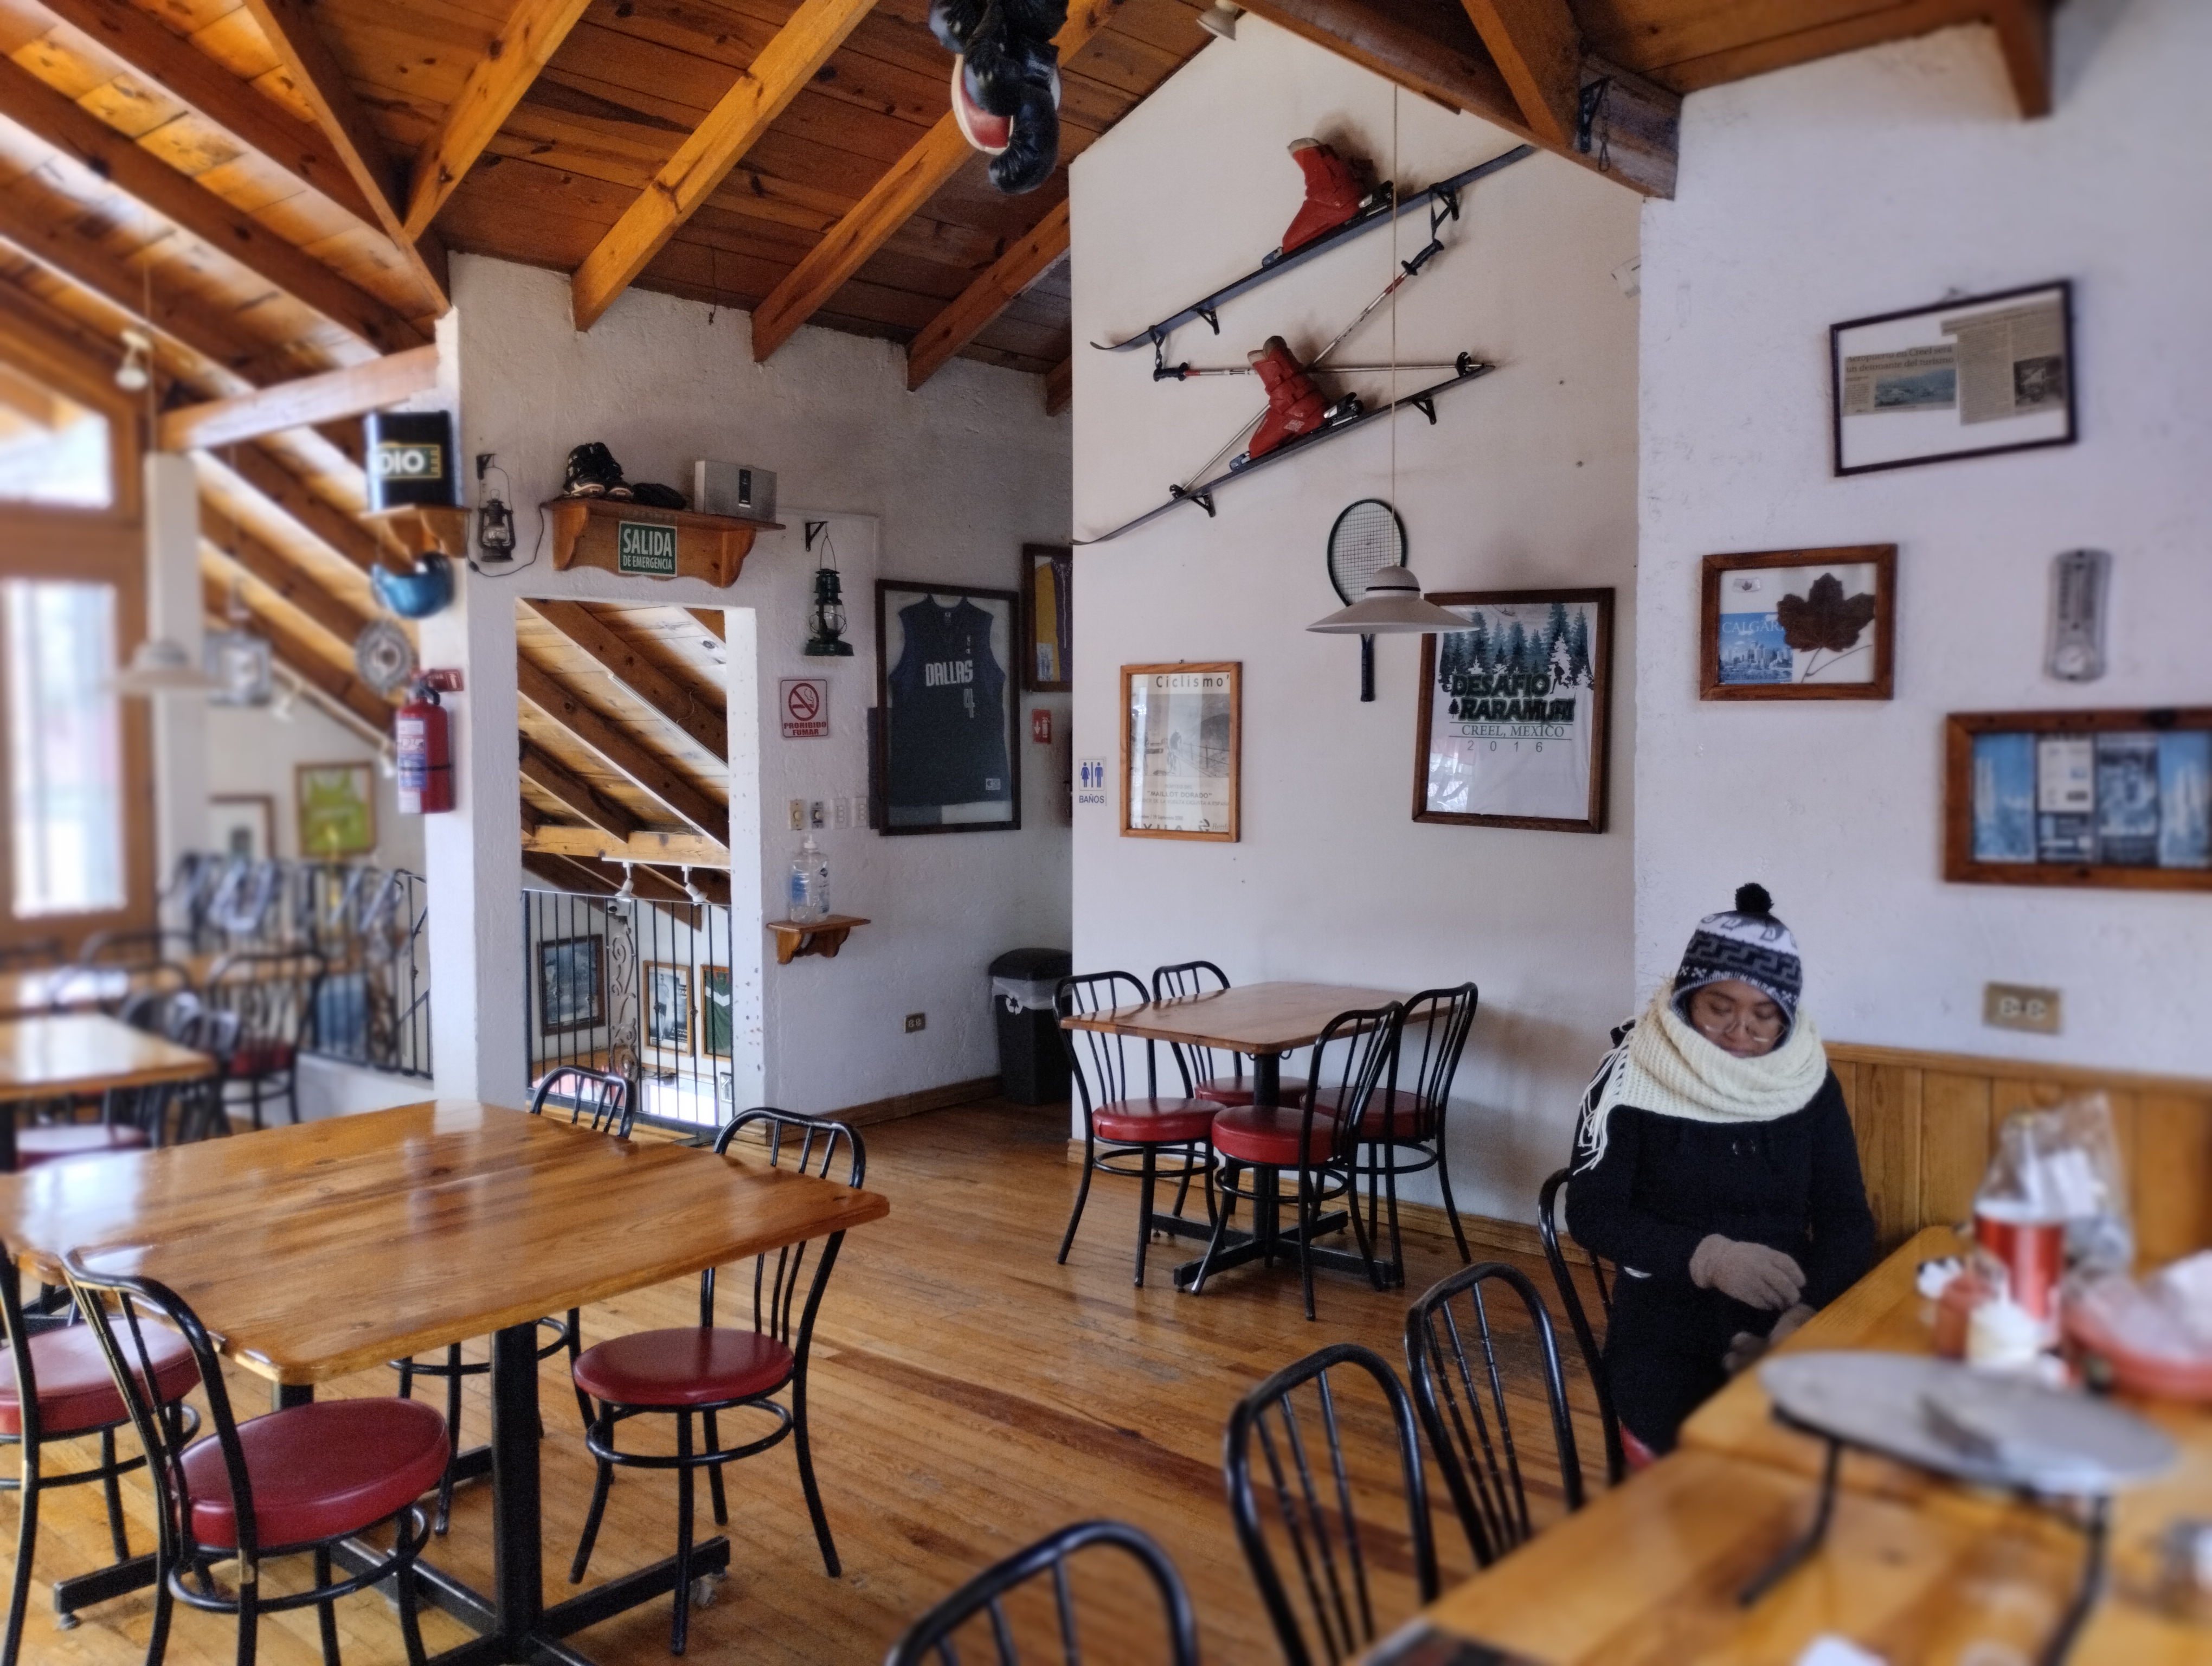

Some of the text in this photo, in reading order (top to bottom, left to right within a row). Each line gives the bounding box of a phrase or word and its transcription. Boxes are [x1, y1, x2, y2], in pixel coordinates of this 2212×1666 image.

[1847, 353, 1894, 363] Aeropuerto
[1909, 347, 1932, 356] Creel
[1859, 360, 1901, 371] detonante
[1904, 358, 1918, 368] del
[1920, 356, 1954, 366] turismo
[623, 528, 672, 557] SALIDA
[623, 555, 672, 570] DE EMERGENCIA
[1722, 620, 1784, 633] CALGAR
[925, 660, 973, 687] DALLAS
[1450, 674, 1551, 697] DESAFIO
[963, 688, 975, 719] 4
[1462, 725, 1506, 738] CREEL,
[1079, 793, 1104, 803] BAÑOS
